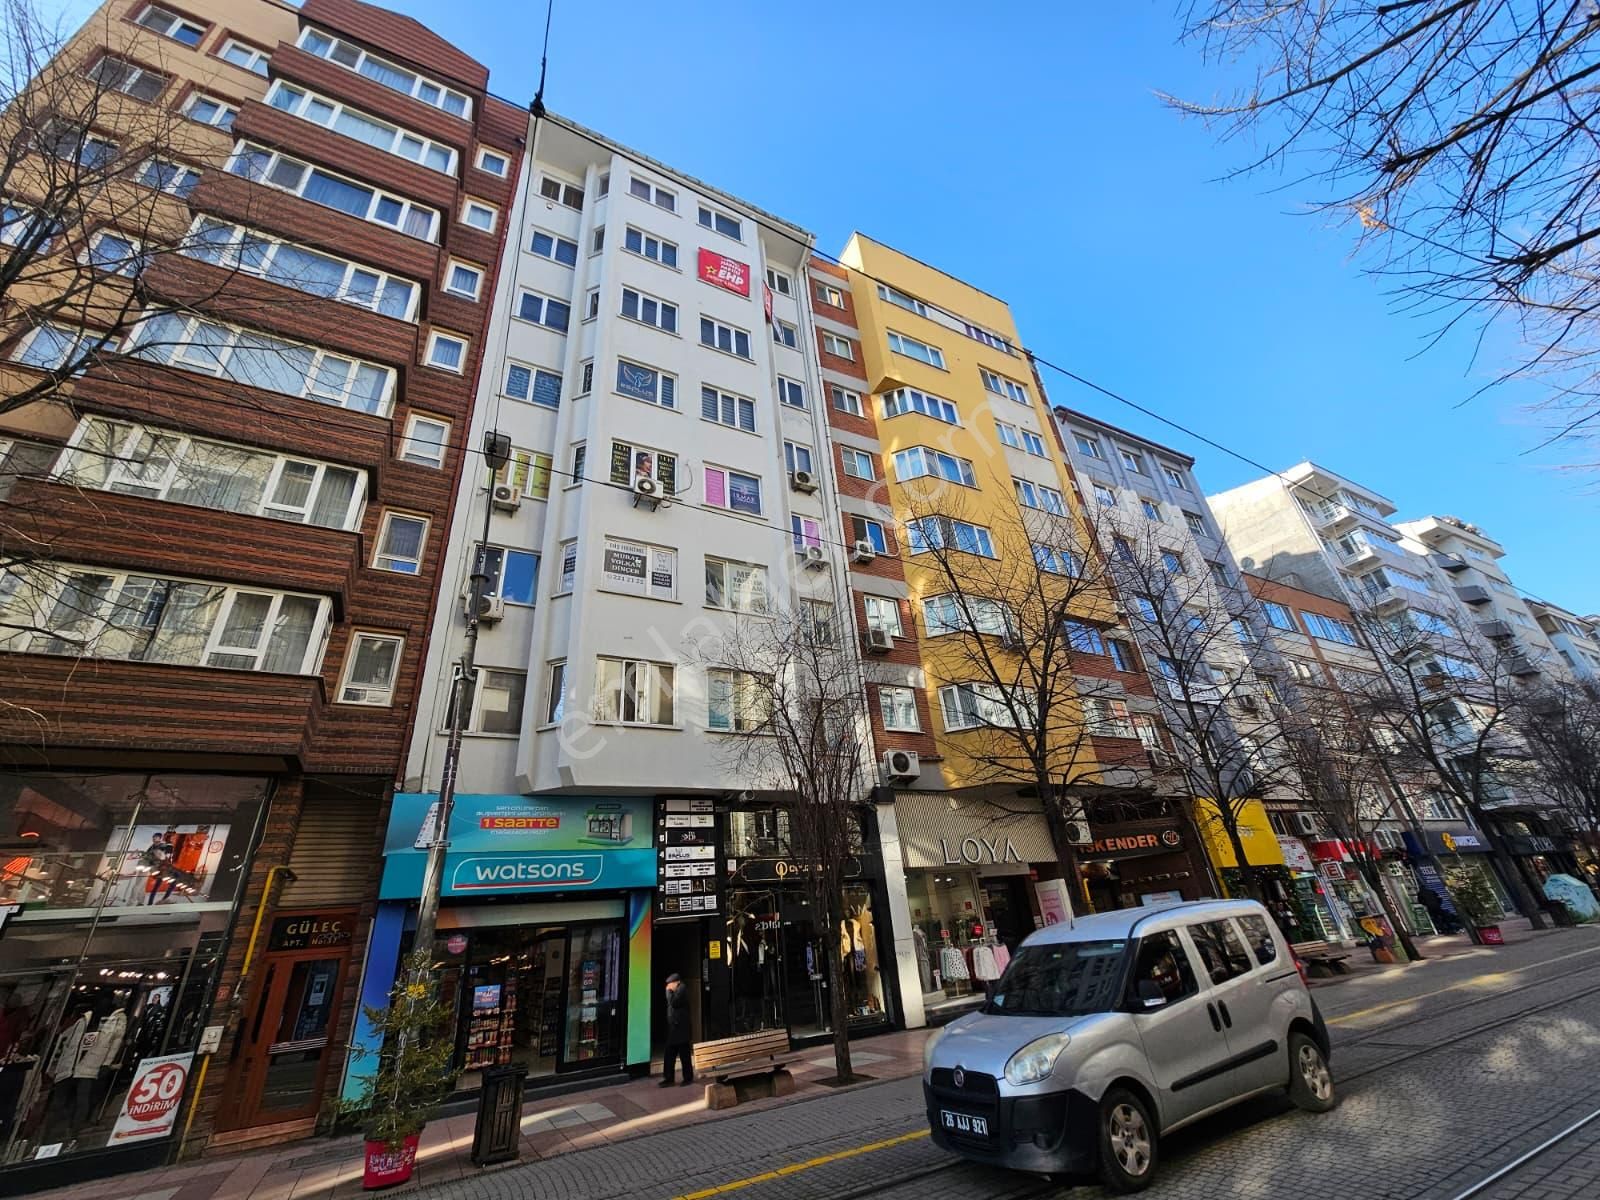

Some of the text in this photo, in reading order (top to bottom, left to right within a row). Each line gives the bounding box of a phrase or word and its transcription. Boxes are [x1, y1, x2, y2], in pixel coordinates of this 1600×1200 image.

[718, 269, 745, 286] EHP
[940, 837, 1022, 864] LOYA
[475, 862, 585, 881] watsons
[286, 920, 341, 935] GÜLEÇ
[134, 1068, 184, 1103] 50
[956, 1115, 970, 1131] AJJ
[972, 1118, 987, 1135] 921
